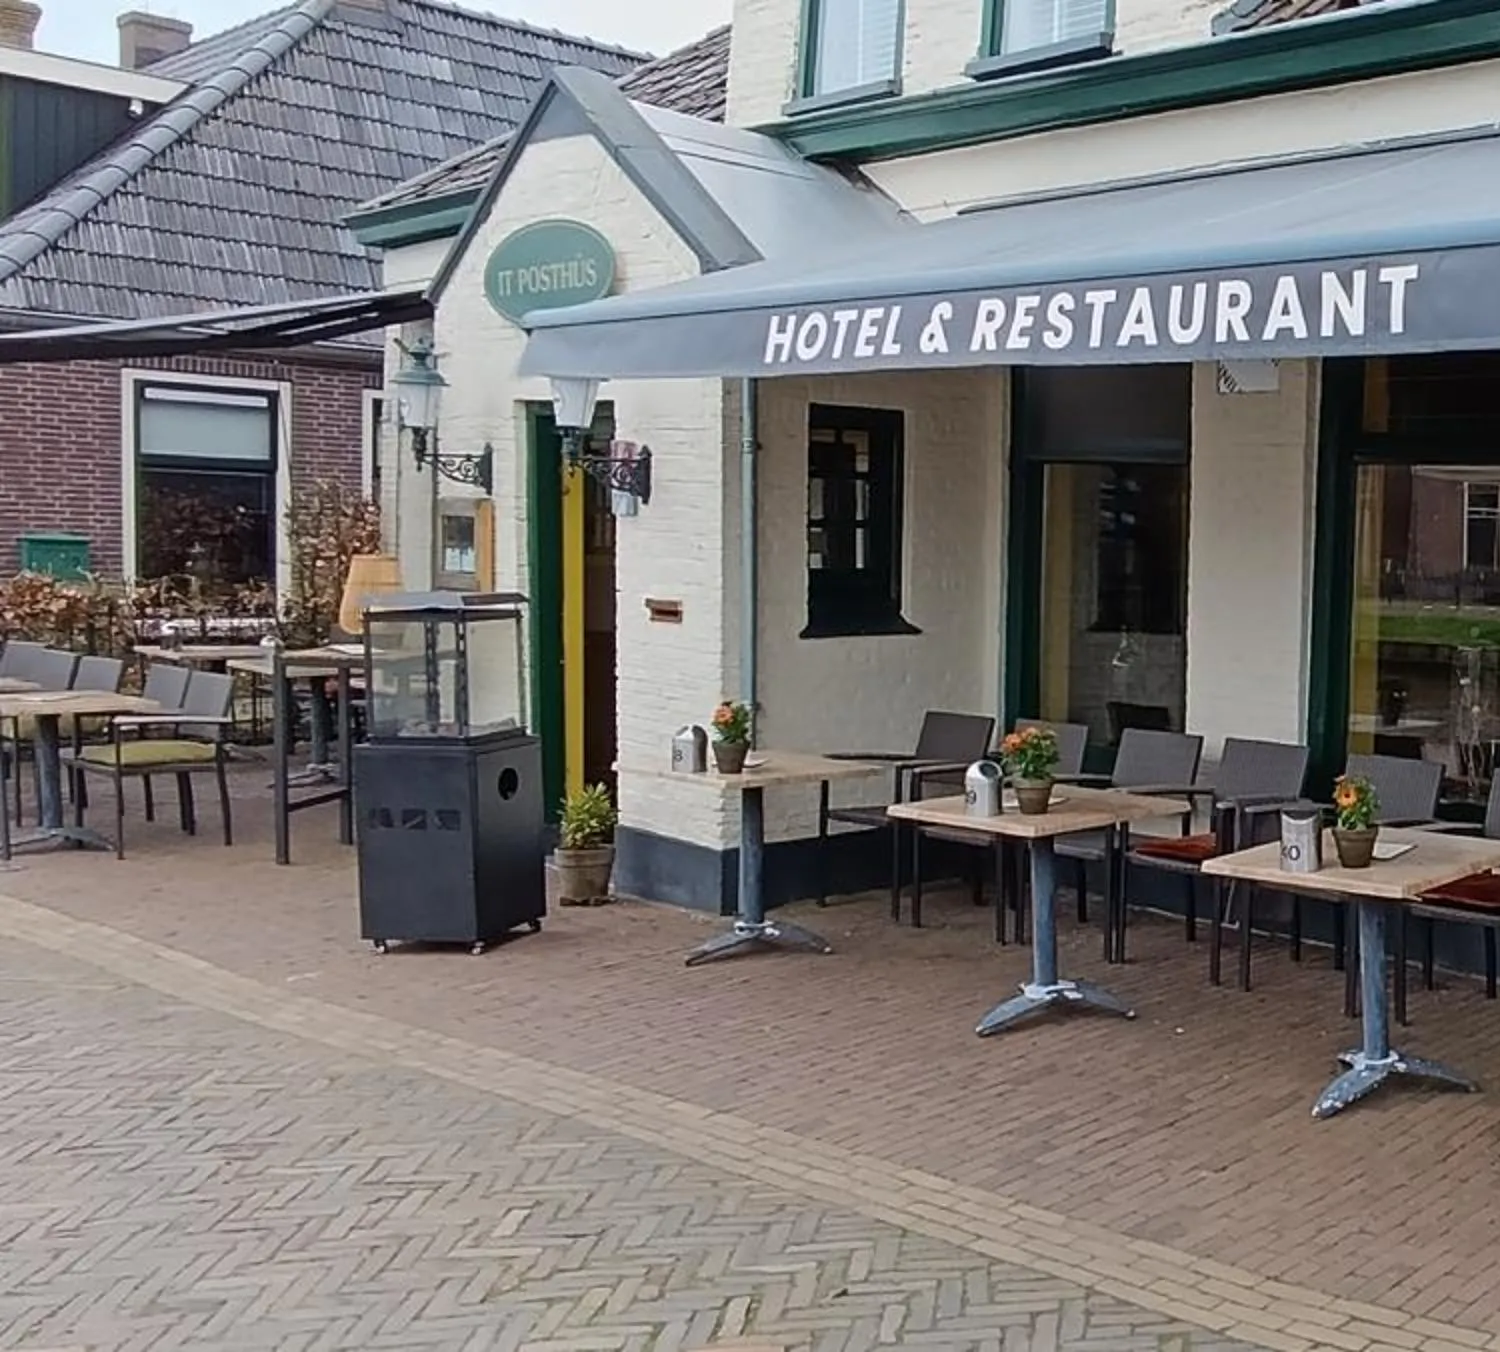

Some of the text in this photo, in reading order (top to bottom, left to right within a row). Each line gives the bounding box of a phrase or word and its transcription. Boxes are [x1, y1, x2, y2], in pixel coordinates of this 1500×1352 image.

[498, 269, 513, 297] IT
[763, 263, 1420, 364] HOTEL & RESTAURANT
